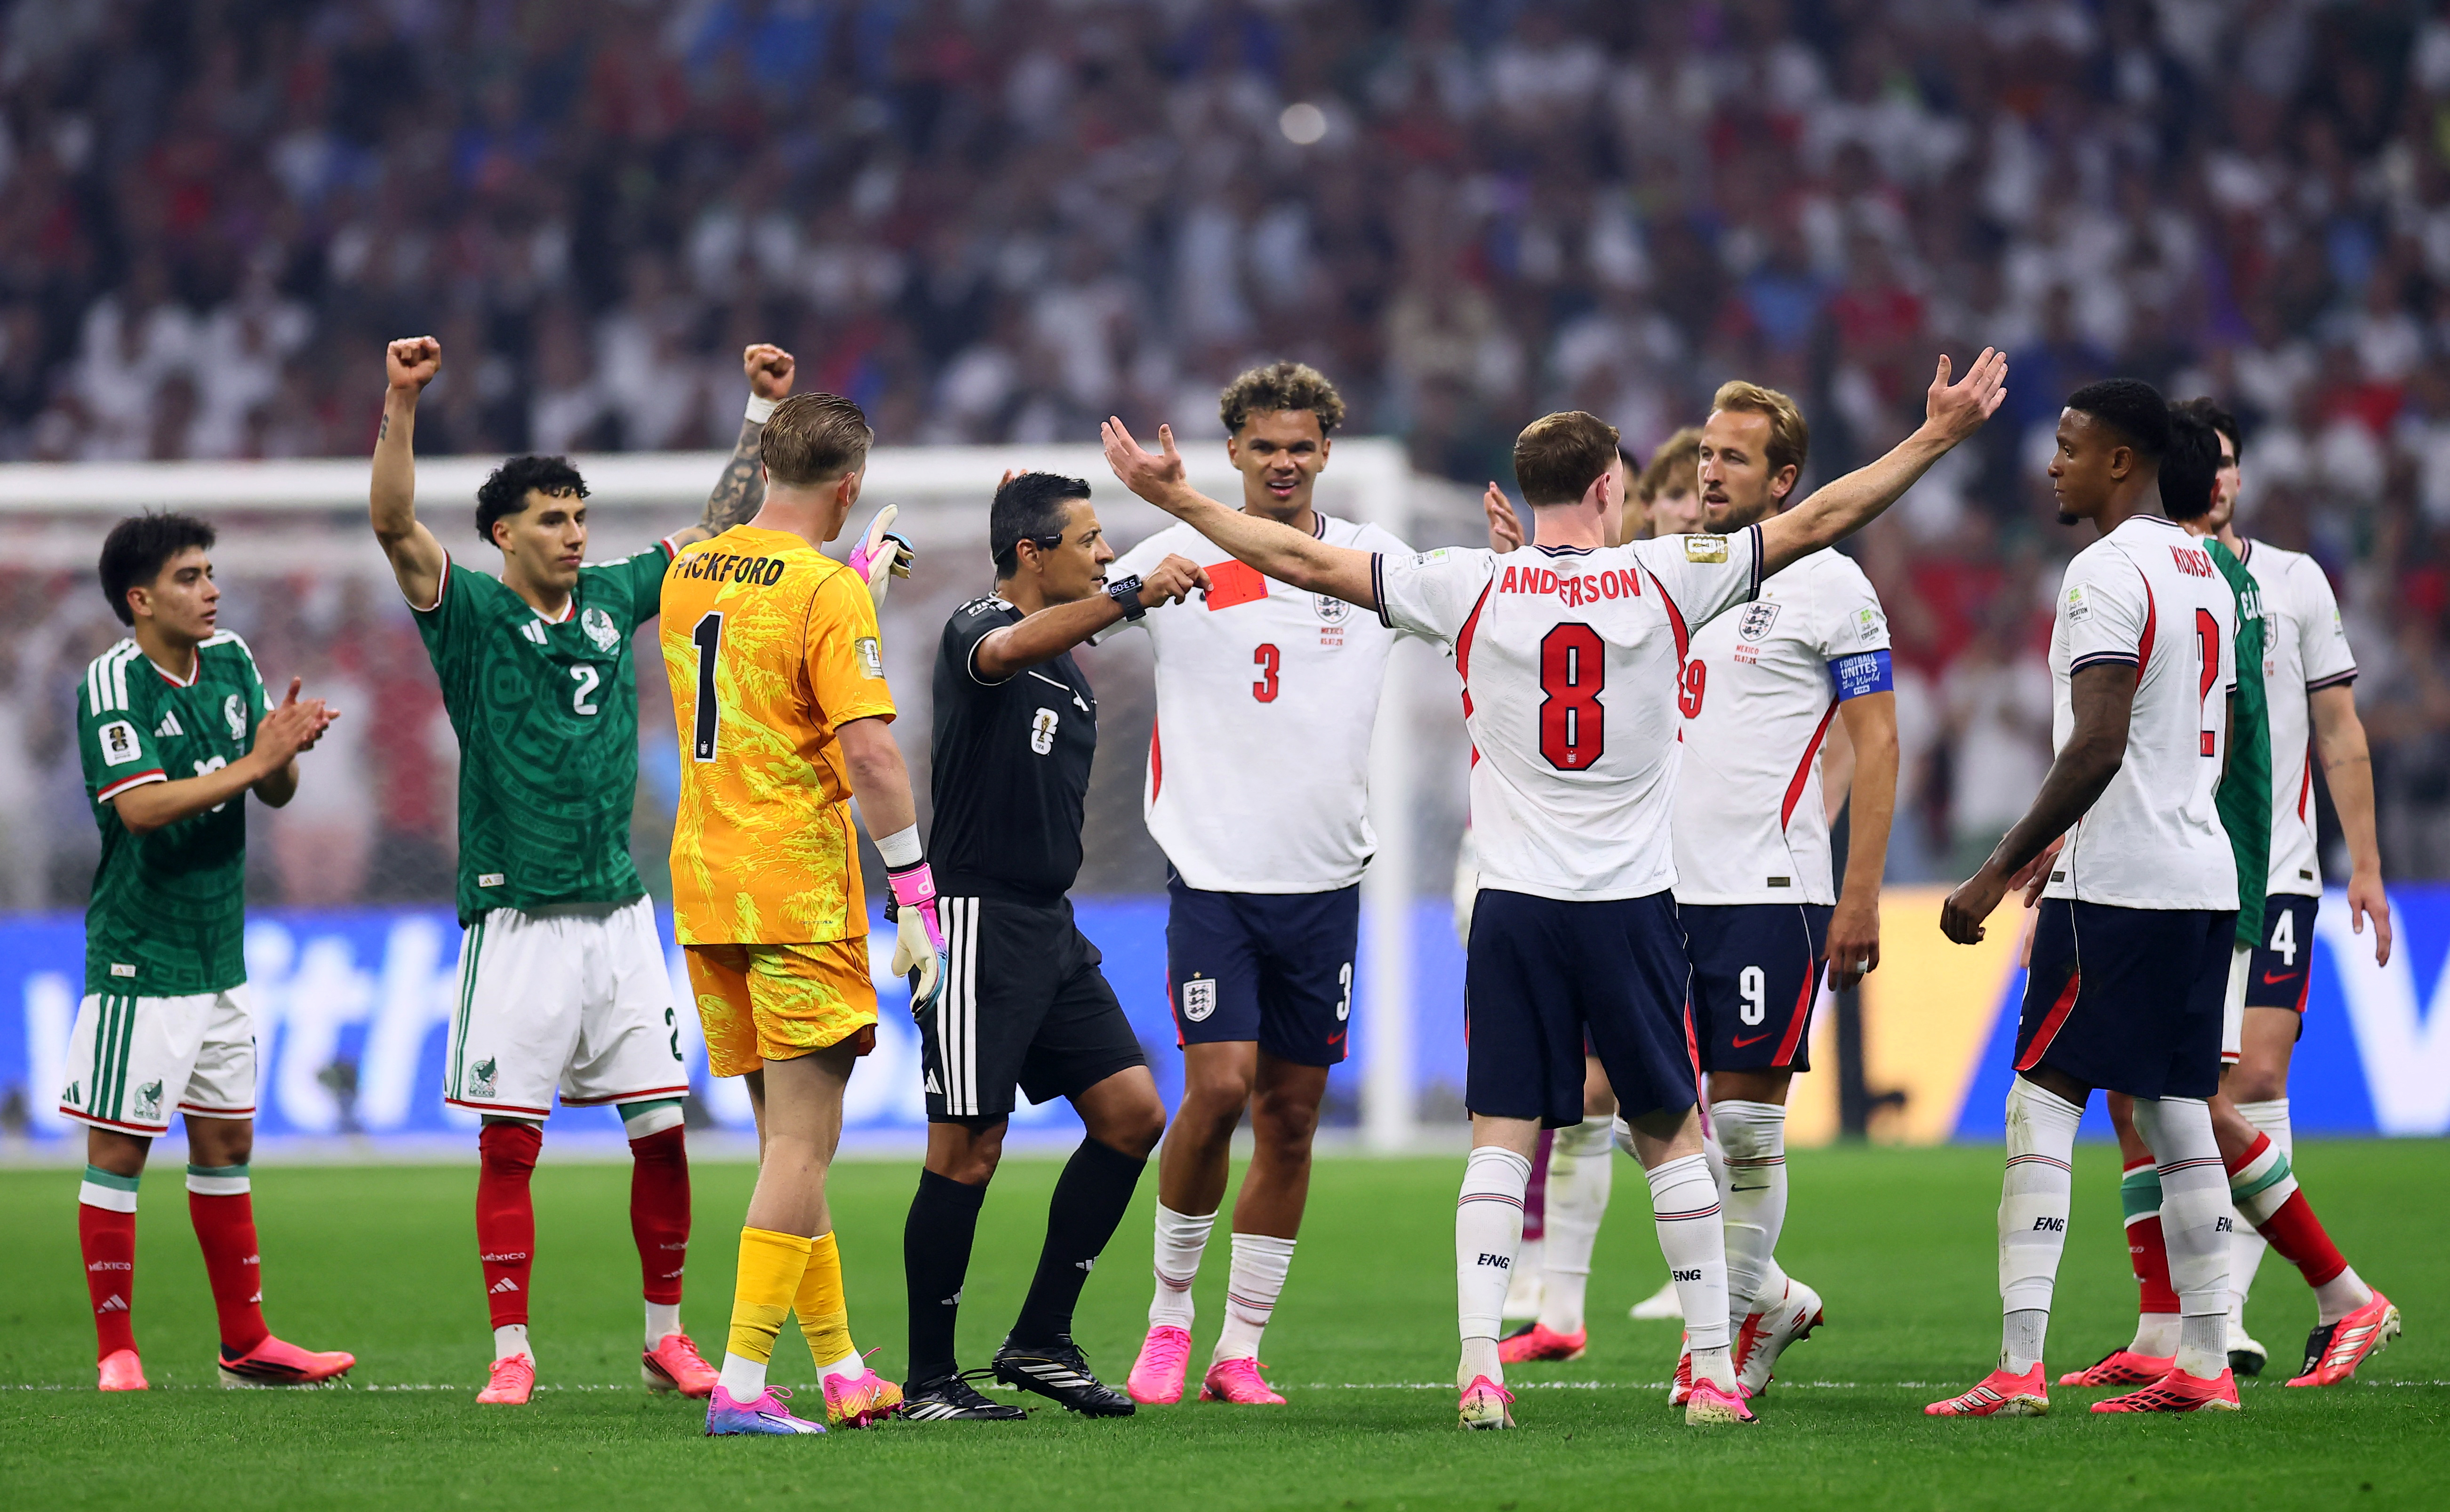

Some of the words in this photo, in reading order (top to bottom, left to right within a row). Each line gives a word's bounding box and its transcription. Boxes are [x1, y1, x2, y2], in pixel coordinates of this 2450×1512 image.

[673, 552, 785, 586] PICKFORD
[2169, 545, 2215, 580] KONSA
[1111, 579, 1136, 593] 53:09
[1499, 566, 1641, 608] ANDERSON
[1736, 645, 1759, 655] MEXICO
[1839, 653, 1876, 669] FOOTBALL
[570, 663, 600, 716] 2
[692, 610, 724, 763] 1
[1253, 643, 1280, 703] 3
[1679, 659, 1706, 720] 9
[1841, 661, 1878, 680] UNITES
[1856, 671, 1880, 686] World
[2196, 608, 2219, 758] 2
[1539, 622, 1605, 771] 8
[2270, 909, 2297, 966] 4
[1336, 961, 1352, 1021] 3
[1740, 965, 1765, 1025] 9
[665, 1007, 683, 1061] 2
[2033, 1217, 2065, 1232] ENG
[1478, 1253, 1510, 1269] ENG
[1672, 1269, 1701, 1281] ENG
[830, 1386, 842, 1406] ULTRA
